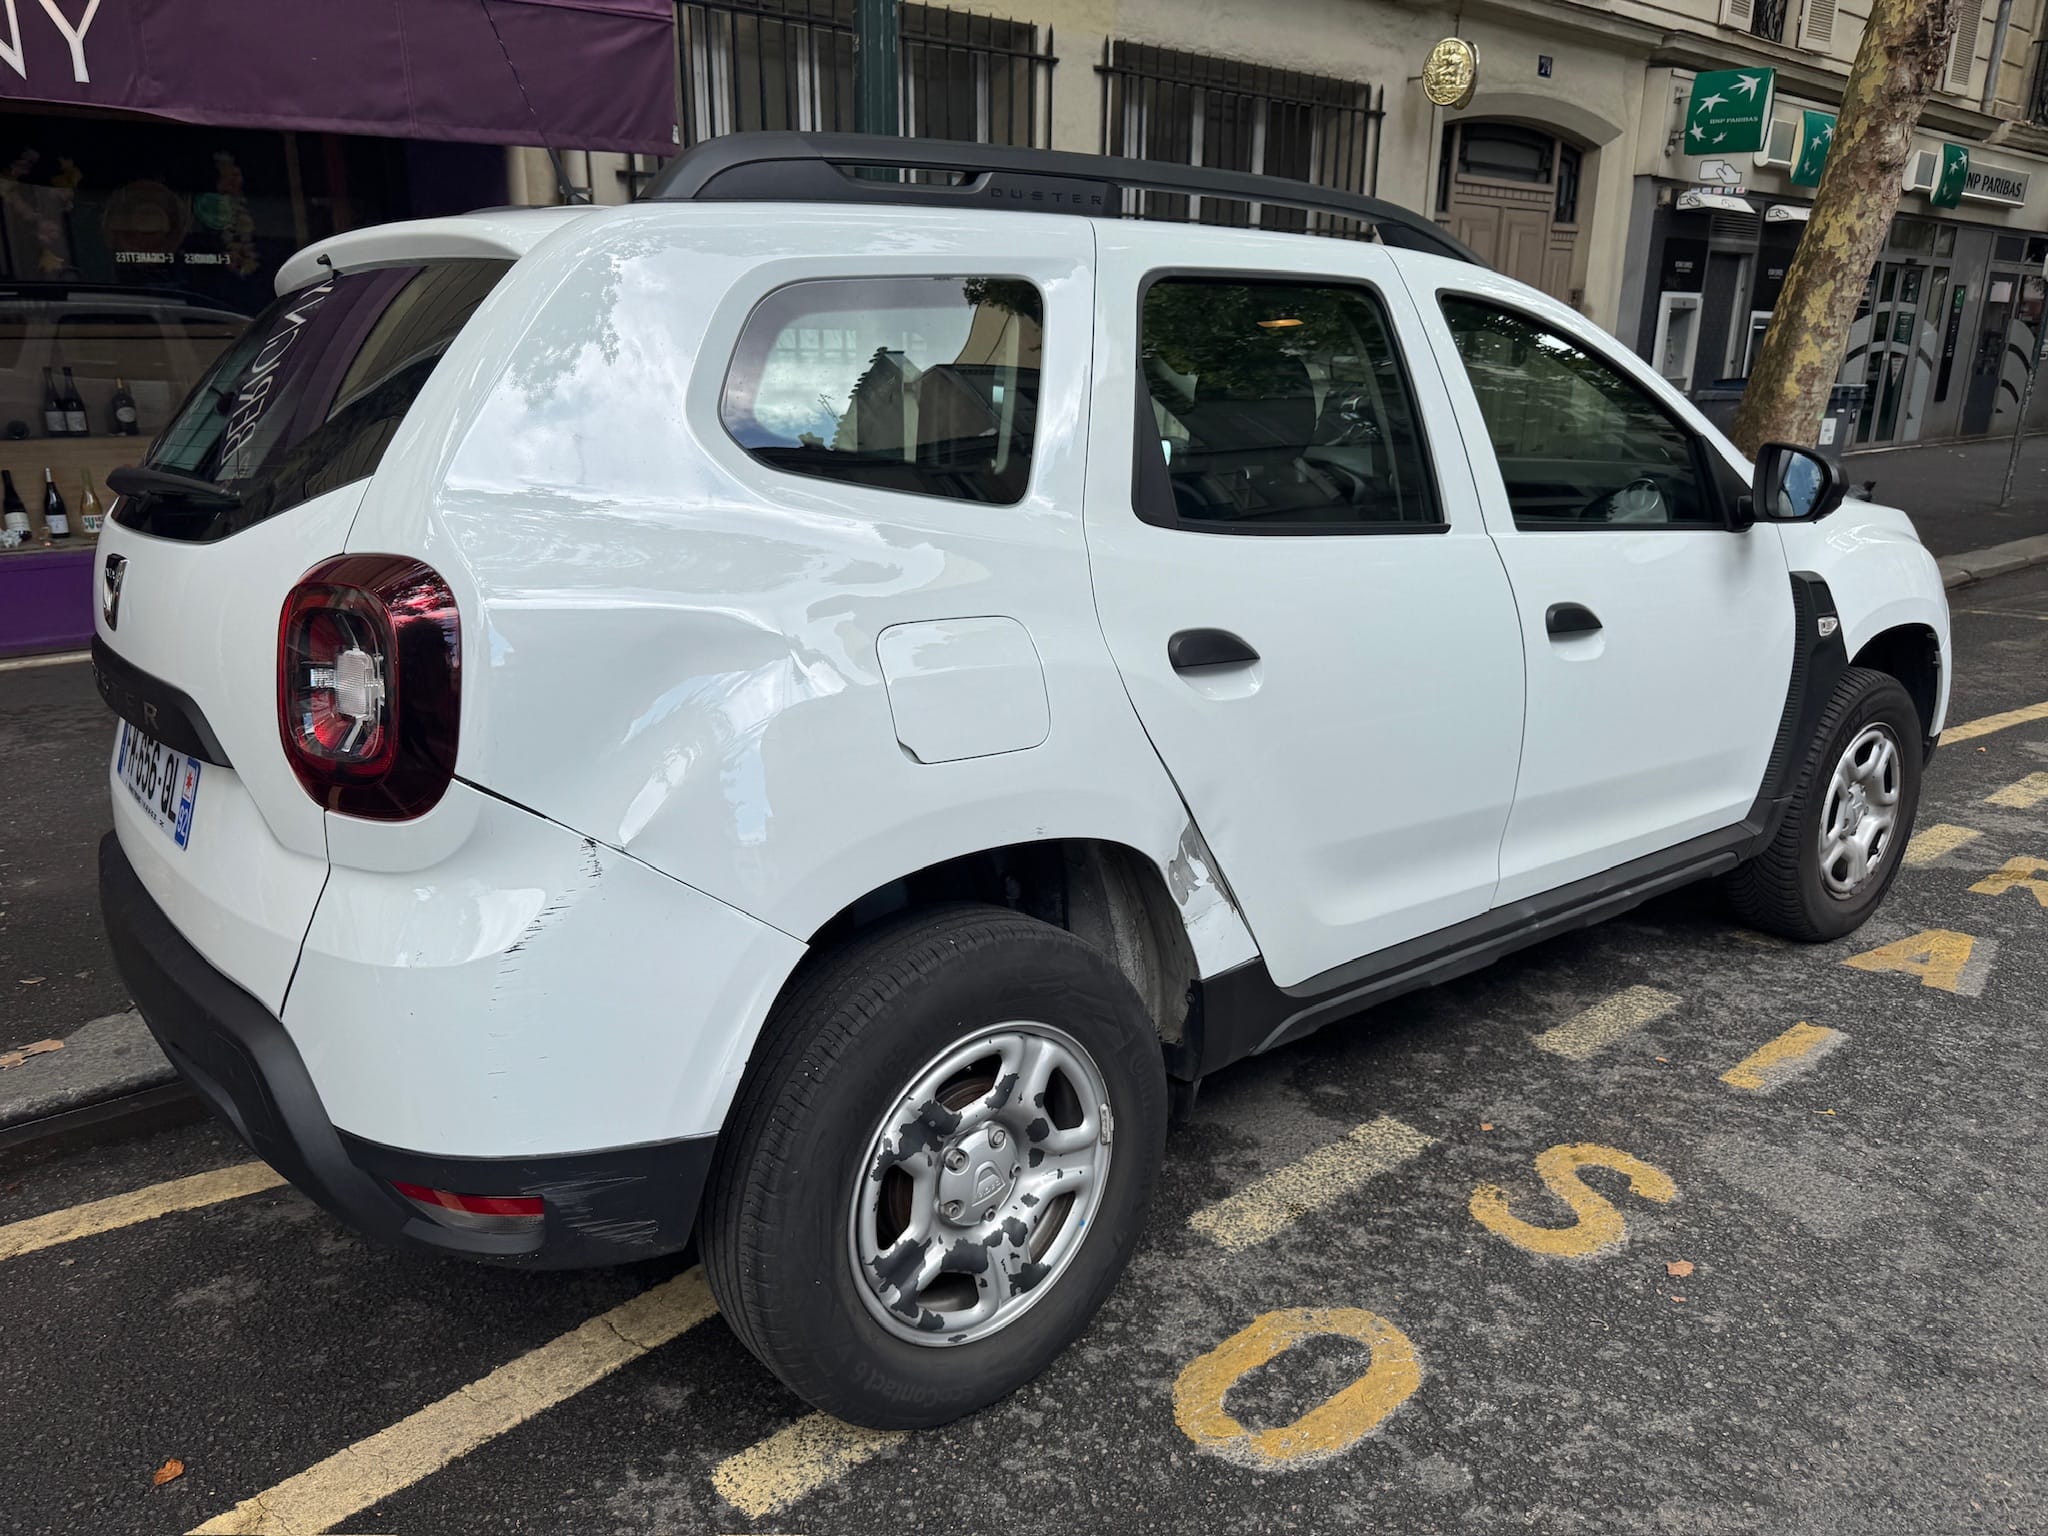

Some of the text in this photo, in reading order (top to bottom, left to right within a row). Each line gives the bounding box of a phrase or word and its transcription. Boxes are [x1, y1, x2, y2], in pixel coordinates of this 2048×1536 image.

[990, 187, 1102, 206] DUSTER
[1966, 172, 2022, 197] NP PARIBAS
[177, 805, 190, 836] 92
